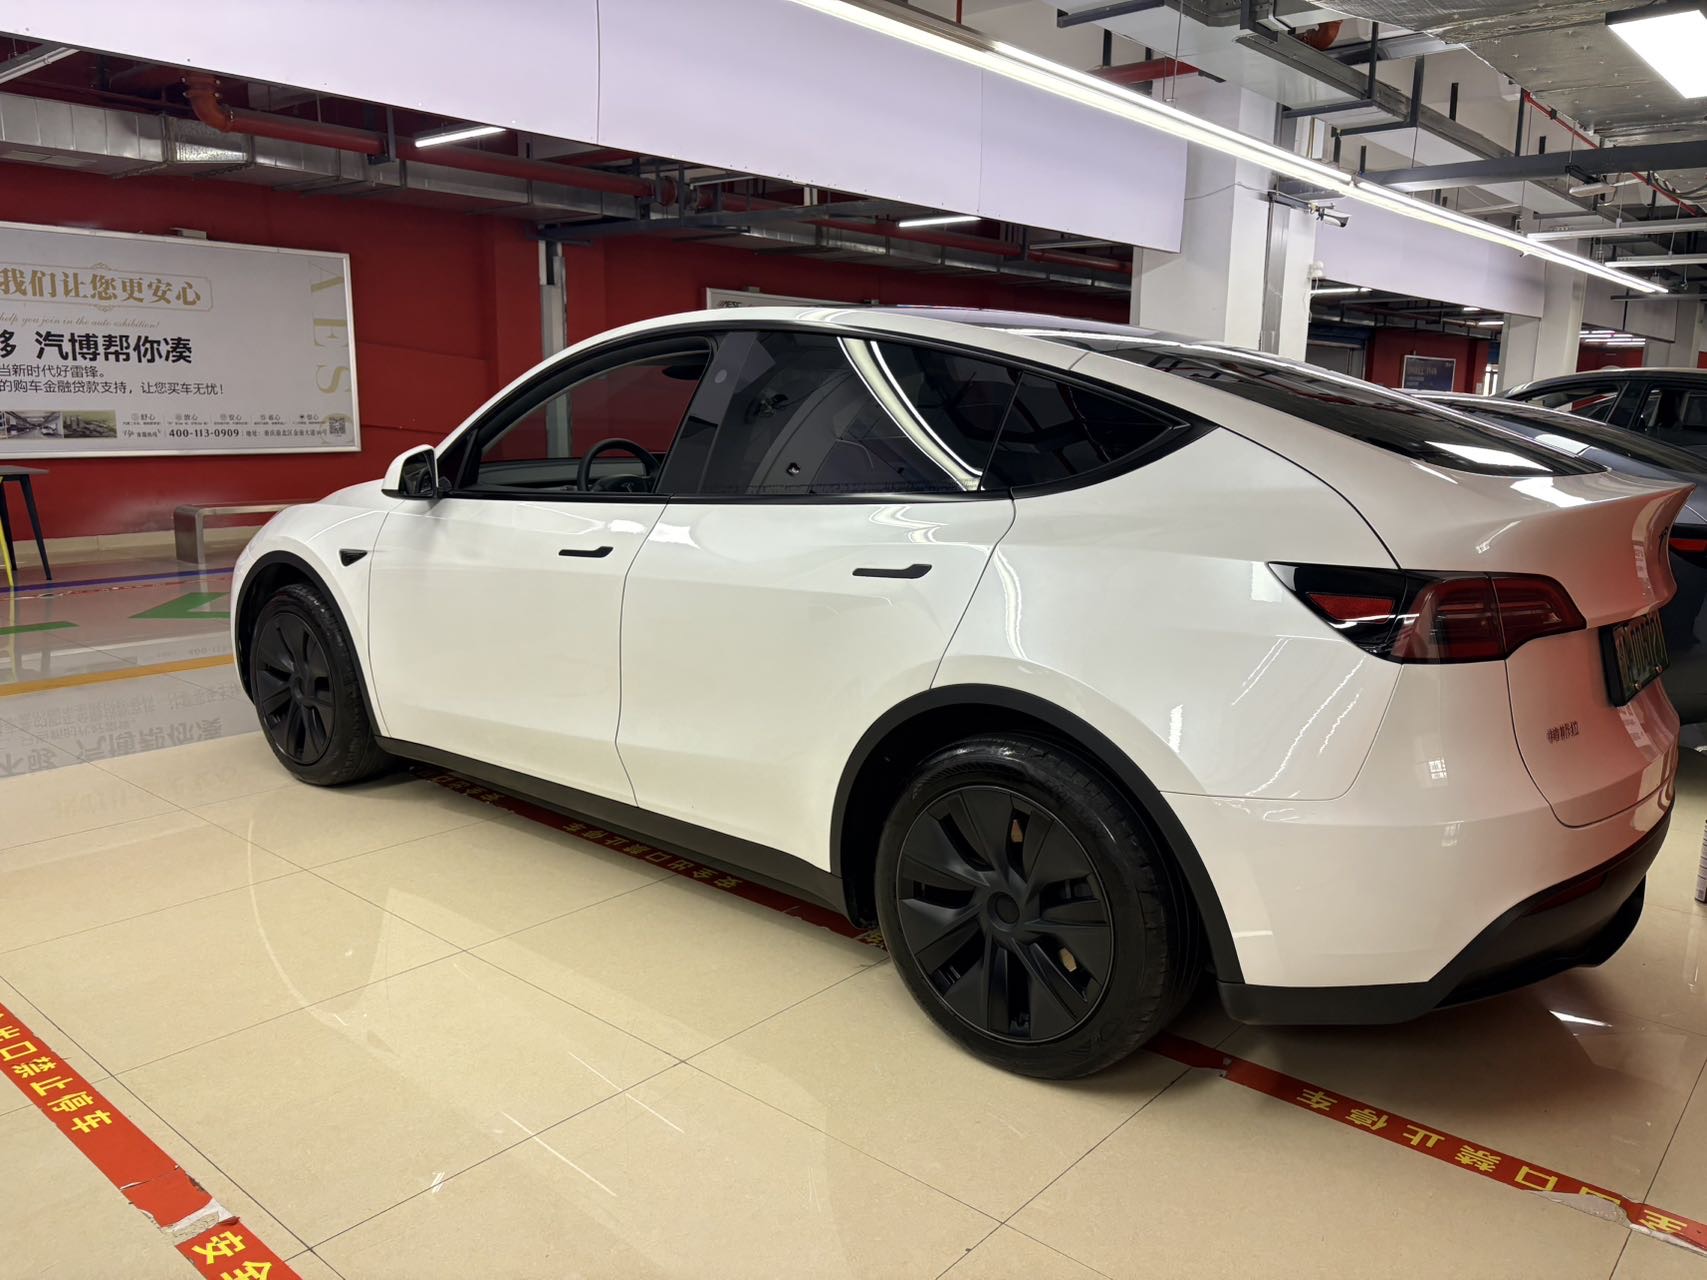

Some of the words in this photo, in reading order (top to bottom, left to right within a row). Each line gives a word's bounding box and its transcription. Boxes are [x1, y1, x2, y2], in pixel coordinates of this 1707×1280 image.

[0, 267, 201, 306] 我们让您更安心
[35, 331, 192, 364] 汽博帮你凑
[0, 363, 104, 379] 当新时代好雷锋。
[169, 428, 239, 438] 400-113-0909
